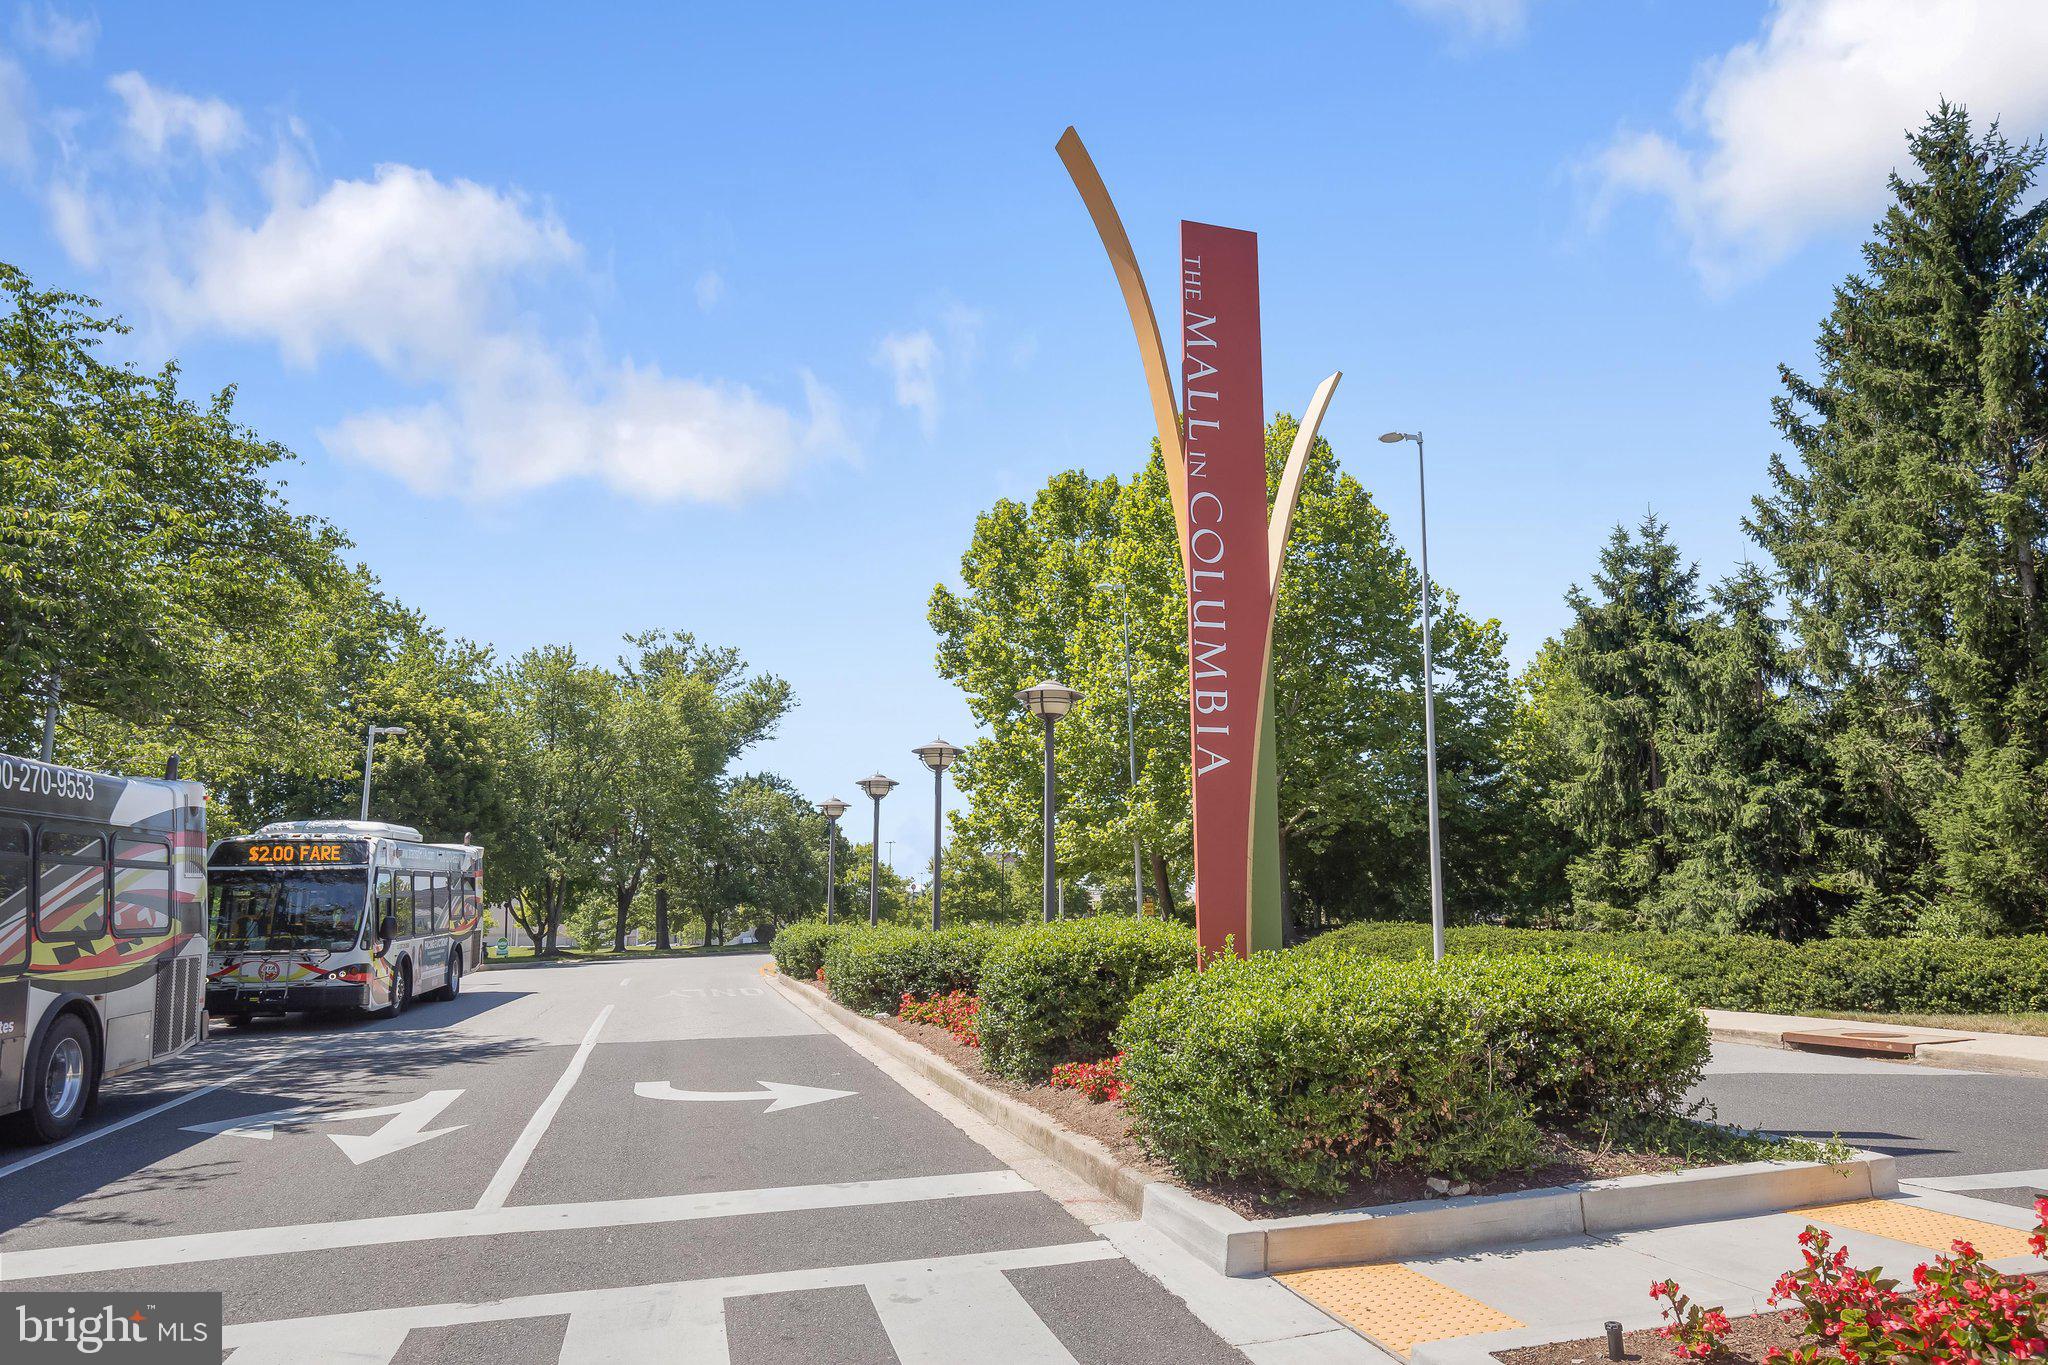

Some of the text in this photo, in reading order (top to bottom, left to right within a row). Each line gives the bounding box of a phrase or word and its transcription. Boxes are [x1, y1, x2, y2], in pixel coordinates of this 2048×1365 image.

[1184, 255, 1231, 777] THE MALL IN COLUMBIA
[0, 760, 95, 801] 0-270-9553
[248, 845, 342, 862] $2.00 FARE
